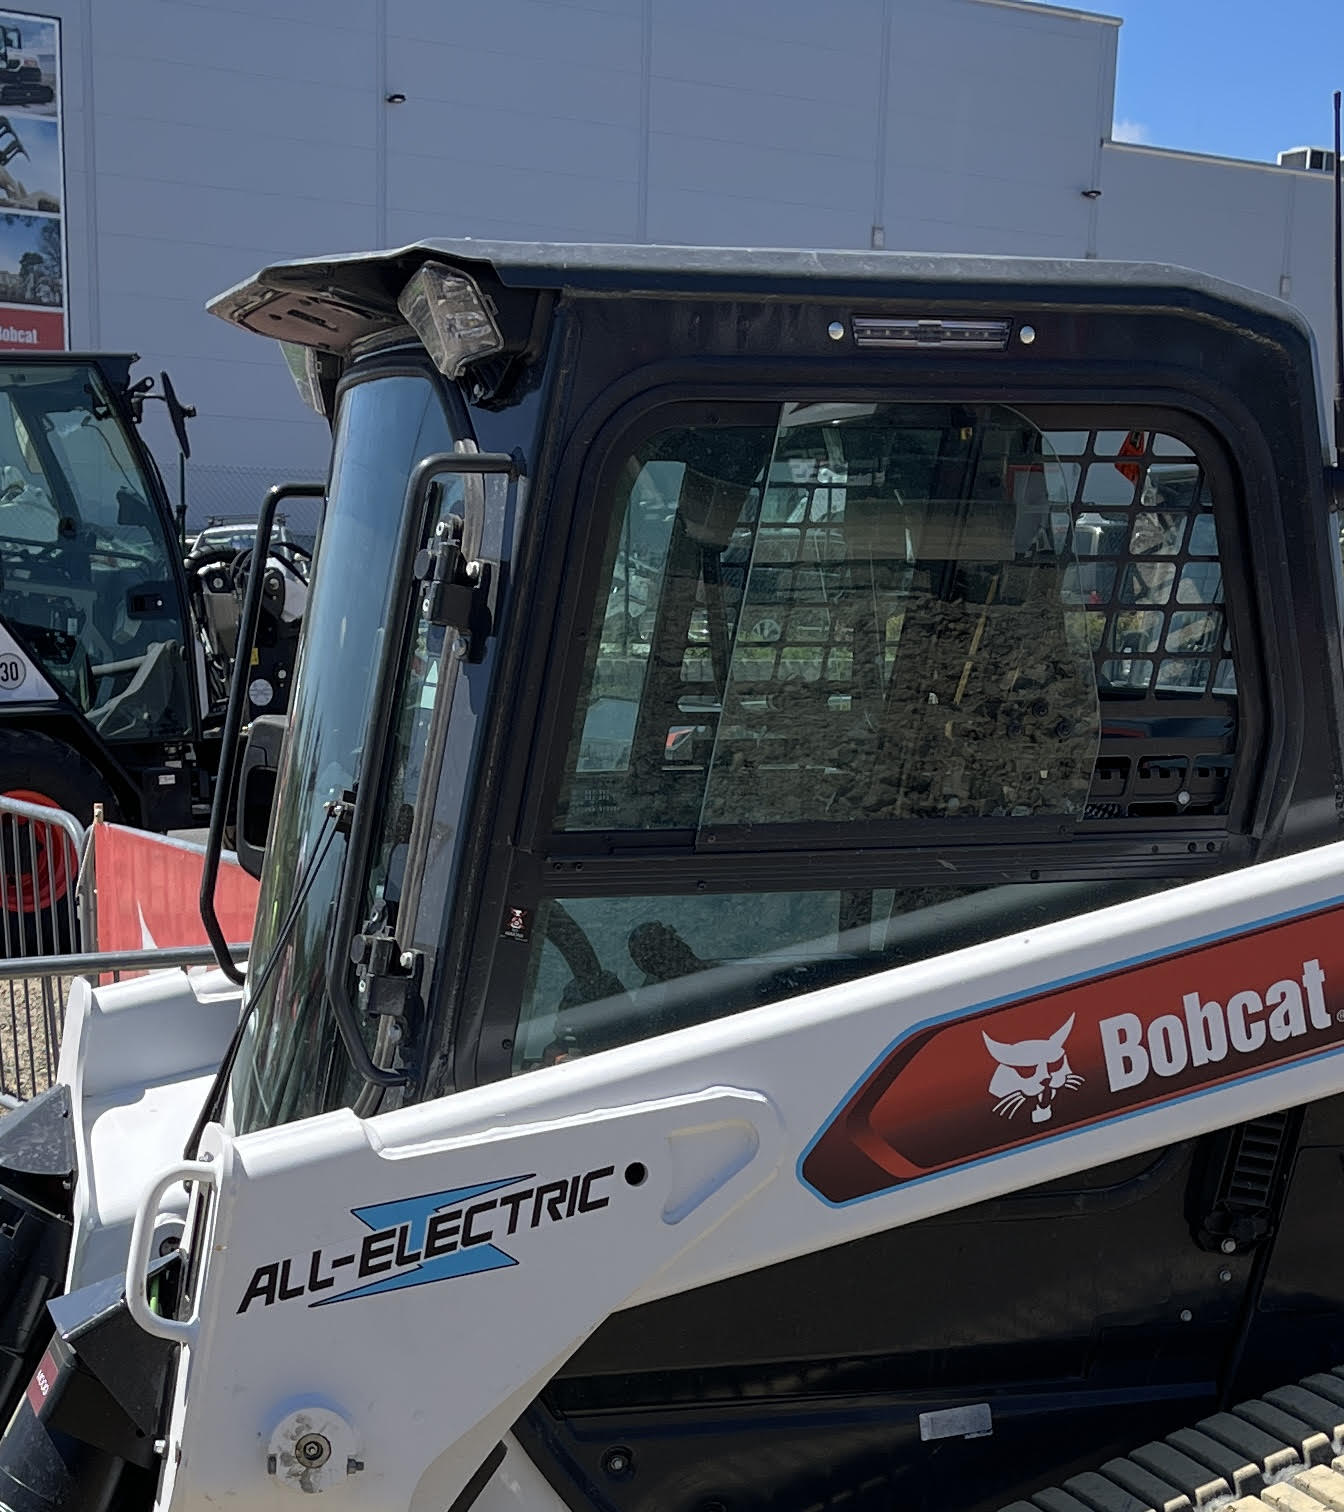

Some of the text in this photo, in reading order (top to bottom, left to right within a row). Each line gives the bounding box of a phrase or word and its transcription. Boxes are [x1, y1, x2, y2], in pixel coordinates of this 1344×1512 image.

[0, 661, 19, 682] 30
[1098, 959, 1334, 1093] Bobcat
[236, 1165, 615, 1315] ALL-ELECTRIC
[36, 1369, 50, 1396] MOOG
